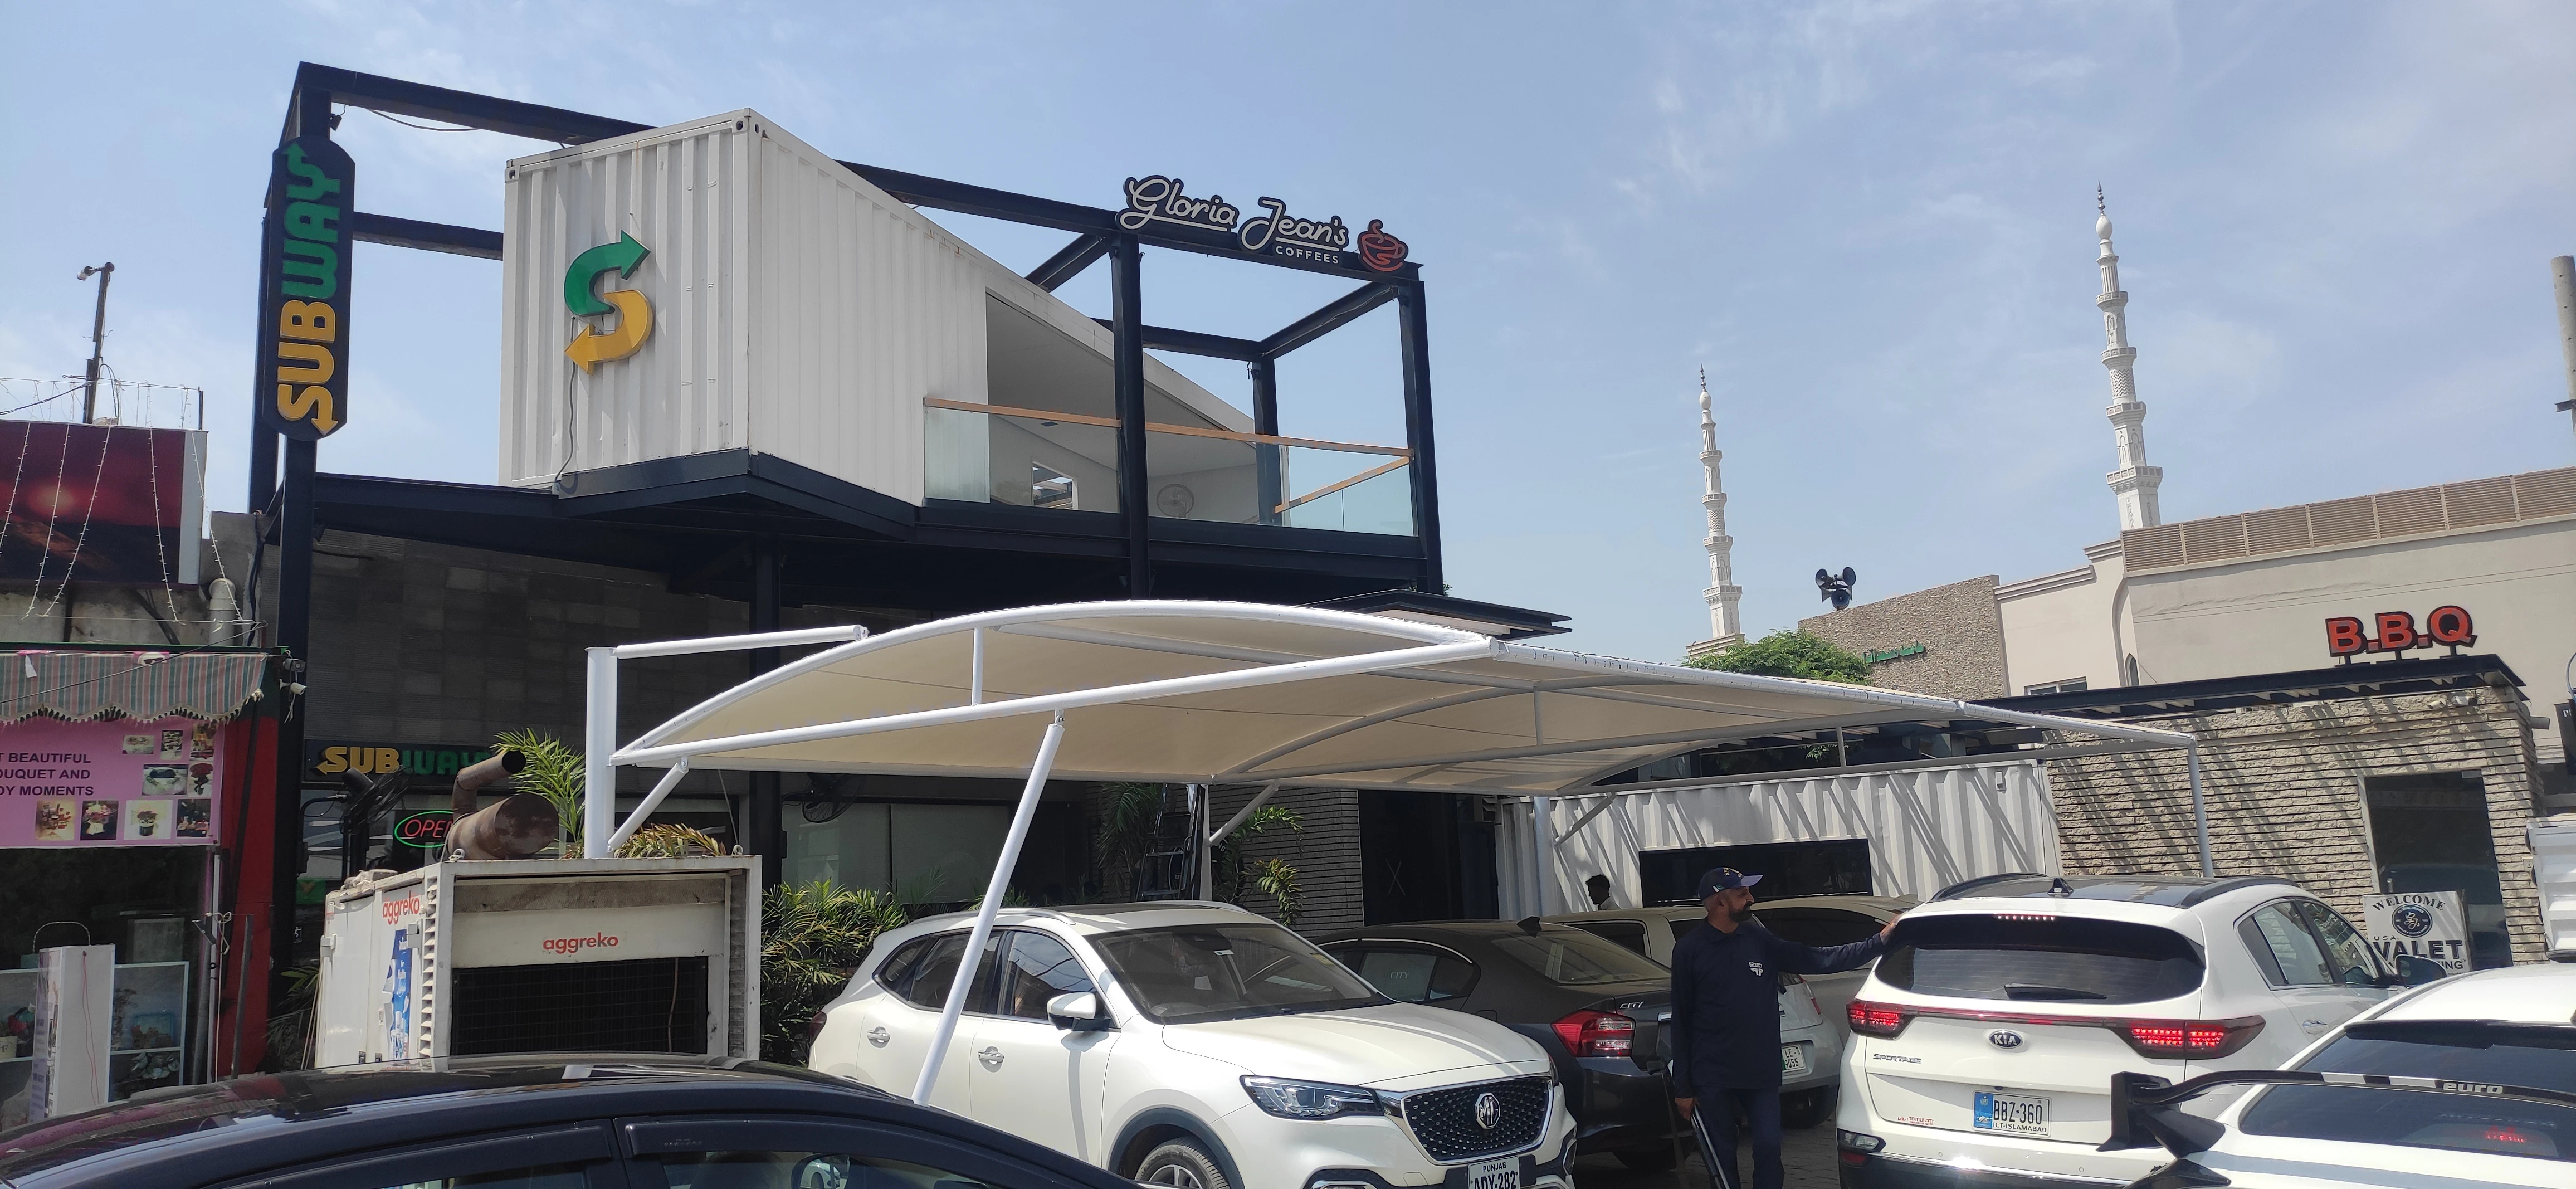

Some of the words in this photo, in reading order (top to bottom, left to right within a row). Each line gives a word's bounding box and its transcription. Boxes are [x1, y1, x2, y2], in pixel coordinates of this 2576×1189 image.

[1119, 177, 1235, 232] Gloria
[1240, 198, 1346, 250] Jean's
[1276, 246, 1339, 264] COFFEES
[277, 143, 340, 435] SUBWAY
[2325, 606, 2477, 657] B.B.Q
[8, 753, 91, 763] BEAUTIFUL
[59, 769, 90, 779] AND
[19, 786, 94, 796] MOMENTS
[382, 890, 421, 925] aggreko
[2373, 895, 2446, 911] WELCOME
[543, 932, 619, 954] aggreko
[2373, 939, 2463, 961] VALET
[1994, 1034, 2017, 1045] KIA
[1784, 1058, 1799, 1069] 9055
[1873, 1054, 1921, 1064] SPORTAGE
[2443, 1083, 2503, 1094] euro
[1993, 1100, 2042, 1125] BBZ-360
[1993, 1122, 2047, 1133] ICT-ISLAMABAD
[1482, 1162, 1507, 1173] PUNJAB
[1474, 1170, 1516, 1189] ADY-282
